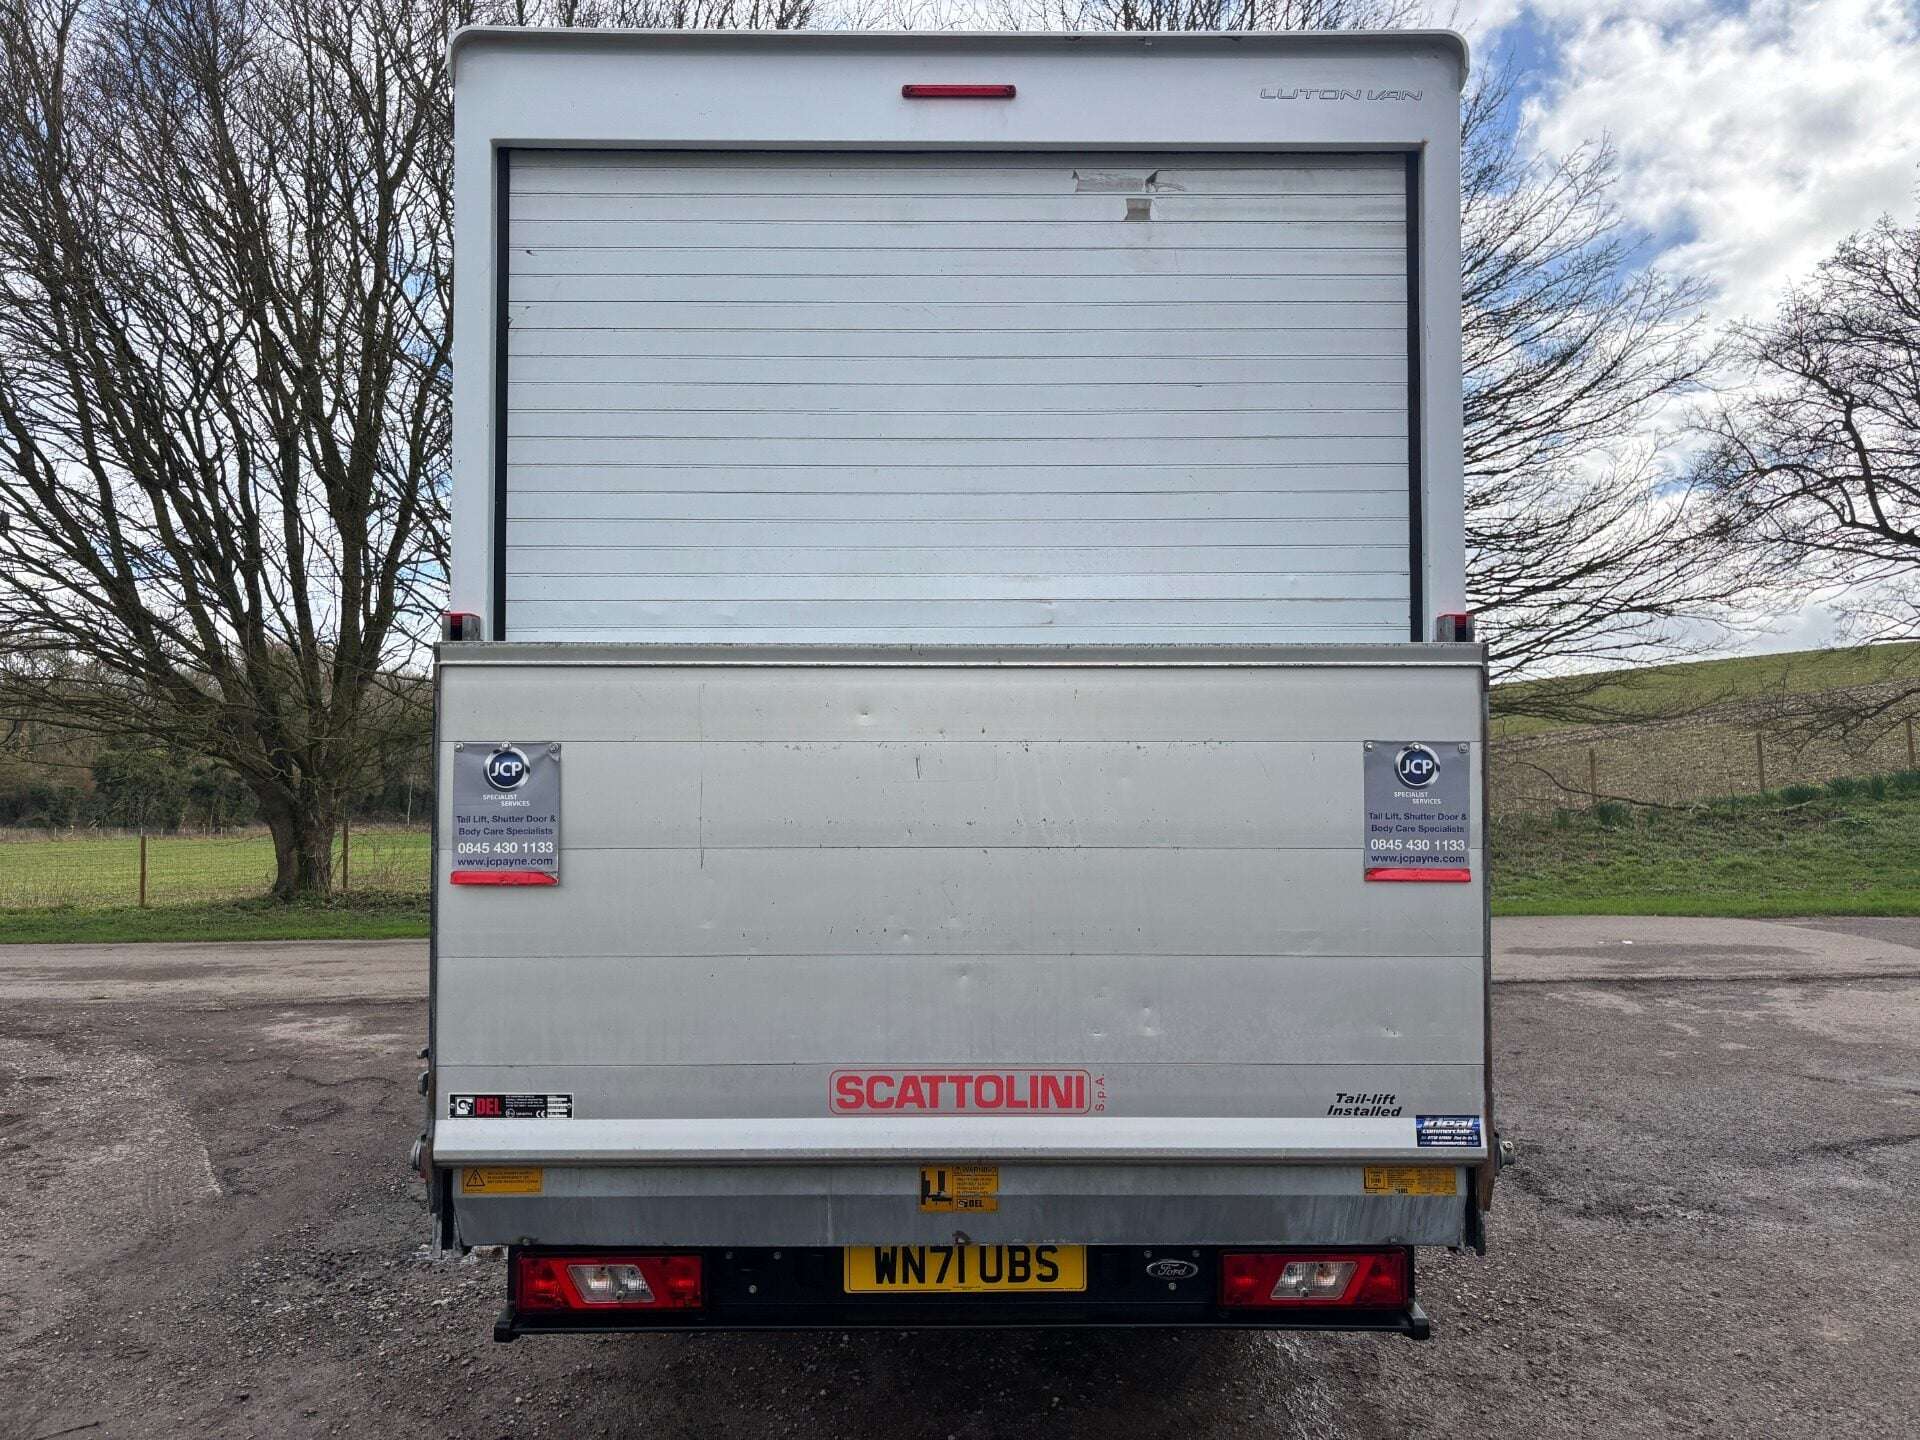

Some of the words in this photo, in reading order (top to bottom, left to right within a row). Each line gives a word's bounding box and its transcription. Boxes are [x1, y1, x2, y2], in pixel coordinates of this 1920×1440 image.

[1260, 88, 1362, 100] LUTON
[1367, 89, 1424, 101] VAN
[491, 761, 523, 777] JCP
[1402, 759, 1434, 774] JCP
[456, 815, 471, 823] Tail
[491, 815, 524, 823] Shutter
[526, 815, 547, 823] Door
[550, 815, 556, 823] &
[1369, 812, 1383, 820] Tail
[1403, 812, 1436, 820] Shutter
[1437, 812, 1458, 820] Door
[1461, 812, 1467, 820] &
[458, 827, 481, 836] Body
[483, 827, 505, 835] Care
[506, 827, 553, 836] Specialists
[1371, 824, 1393, 833] Body
[1395, 825, 1416, 833] Care
[1418, 825, 1465, 834] Specialists
[457, 842, 490, 853] 0845
[493, 842, 518, 853] 430
[522, 842, 553, 853] 1133
[1370, 839, 1402, 850] 0845
[1406, 839, 1430, 850] 430
[1434, 839, 1465, 850] 1133
[457, 857, 553, 868] www.jcpayne.com
[1371, 854, 1465, 865] www.jcpayne.com
[836, 1075, 1085, 1109] SCATTOLINI
[1336, 1093, 1396, 1105] Tail-lift
[476, 1097, 501, 1115] DEL
[1327, 1105, 1402, 1117] Installed
[1423, 1117, 1474, 1129] ideal
[967, 1200, 984, 1208] DEL
[874, 1245, 966, 1284] WN71
[979, 1245, 1060, 1283] UBS
[1158, 1263, 1188, 1276] Ford
